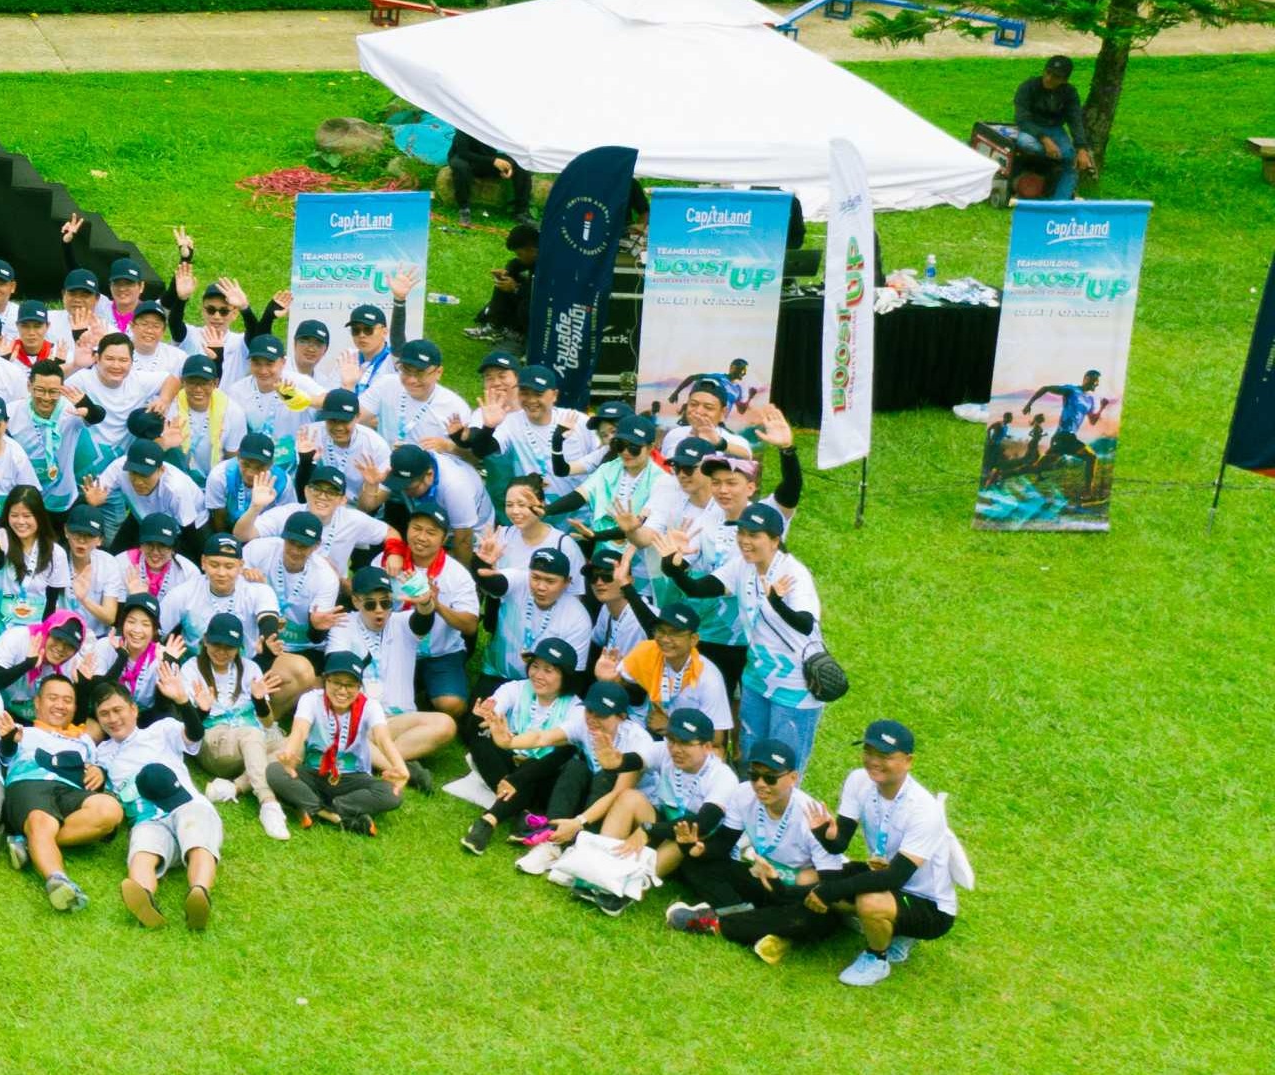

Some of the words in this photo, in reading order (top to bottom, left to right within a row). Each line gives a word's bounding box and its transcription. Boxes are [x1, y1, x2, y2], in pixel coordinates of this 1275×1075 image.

[330, 210, 394, 230] CapitaLand
[685, 205, 752, 227] CapitaLand
[1045, 218, 1110, 238] CapitaLand
[298, 263, 376, 281] BOOST
[653, 258, 731, 276] BOOST
[730, 267, 776, 291] UP
[1012, 270, 1089, 288] BOOST
[1086, 278, 1131, 302] UP
[553, 312, 572, 379] agency
[566, 303, 593, 369] ignition
